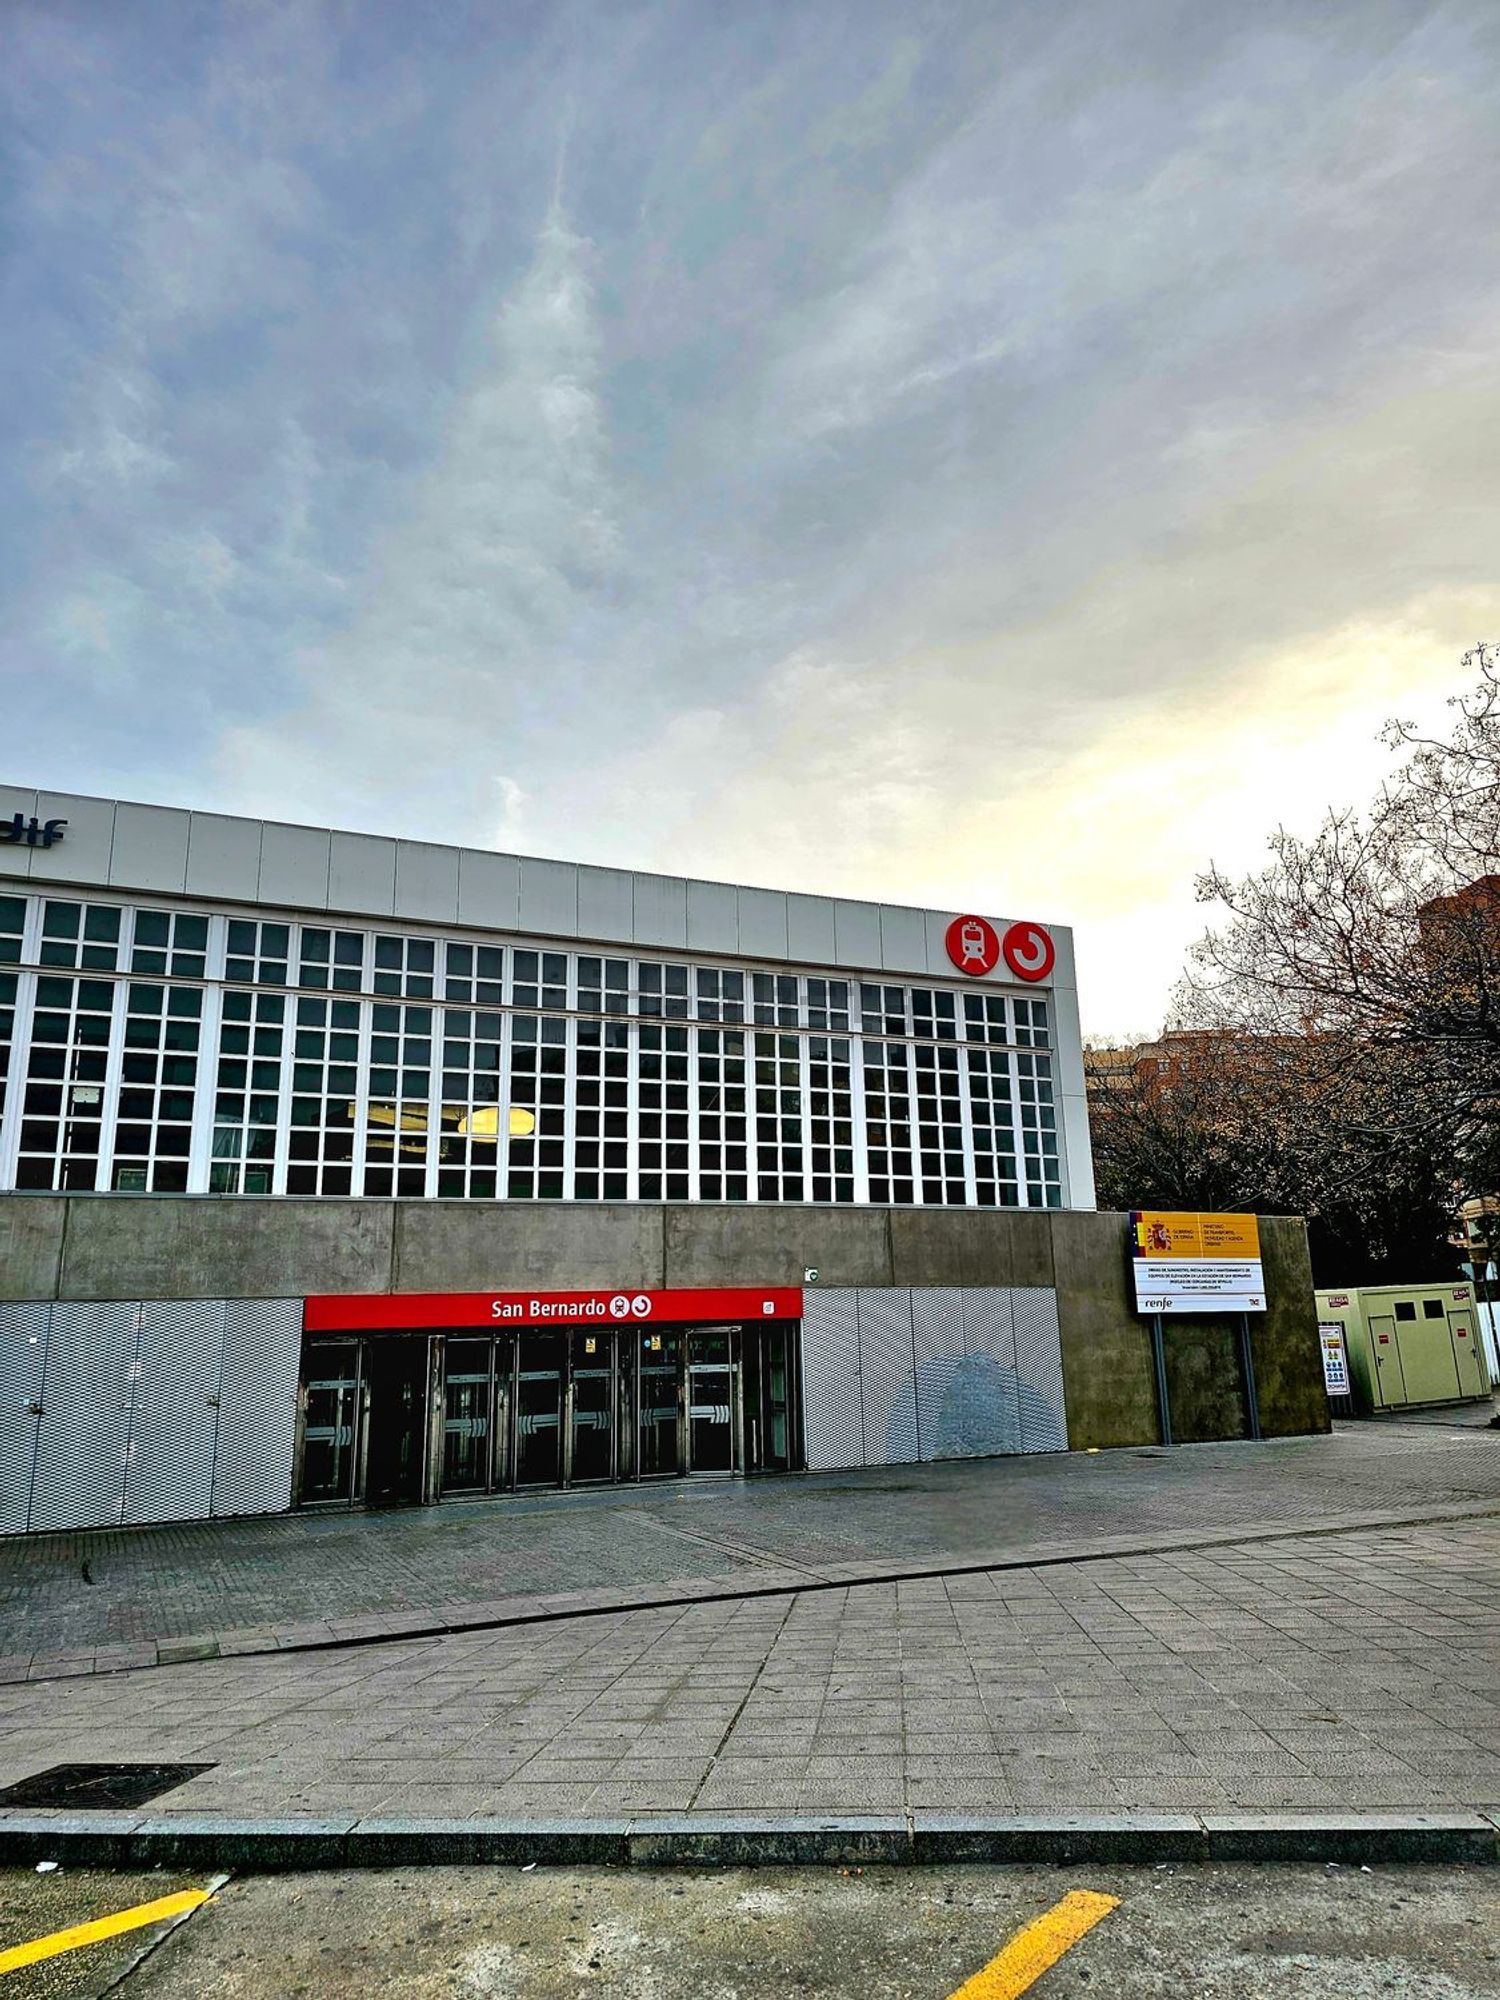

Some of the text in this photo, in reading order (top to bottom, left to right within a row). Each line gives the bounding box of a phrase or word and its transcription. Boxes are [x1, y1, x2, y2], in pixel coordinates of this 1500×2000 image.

[491, 1298, 606, 1318] San Bernardo
[1145, 1297, 1173, 1310] renfe
